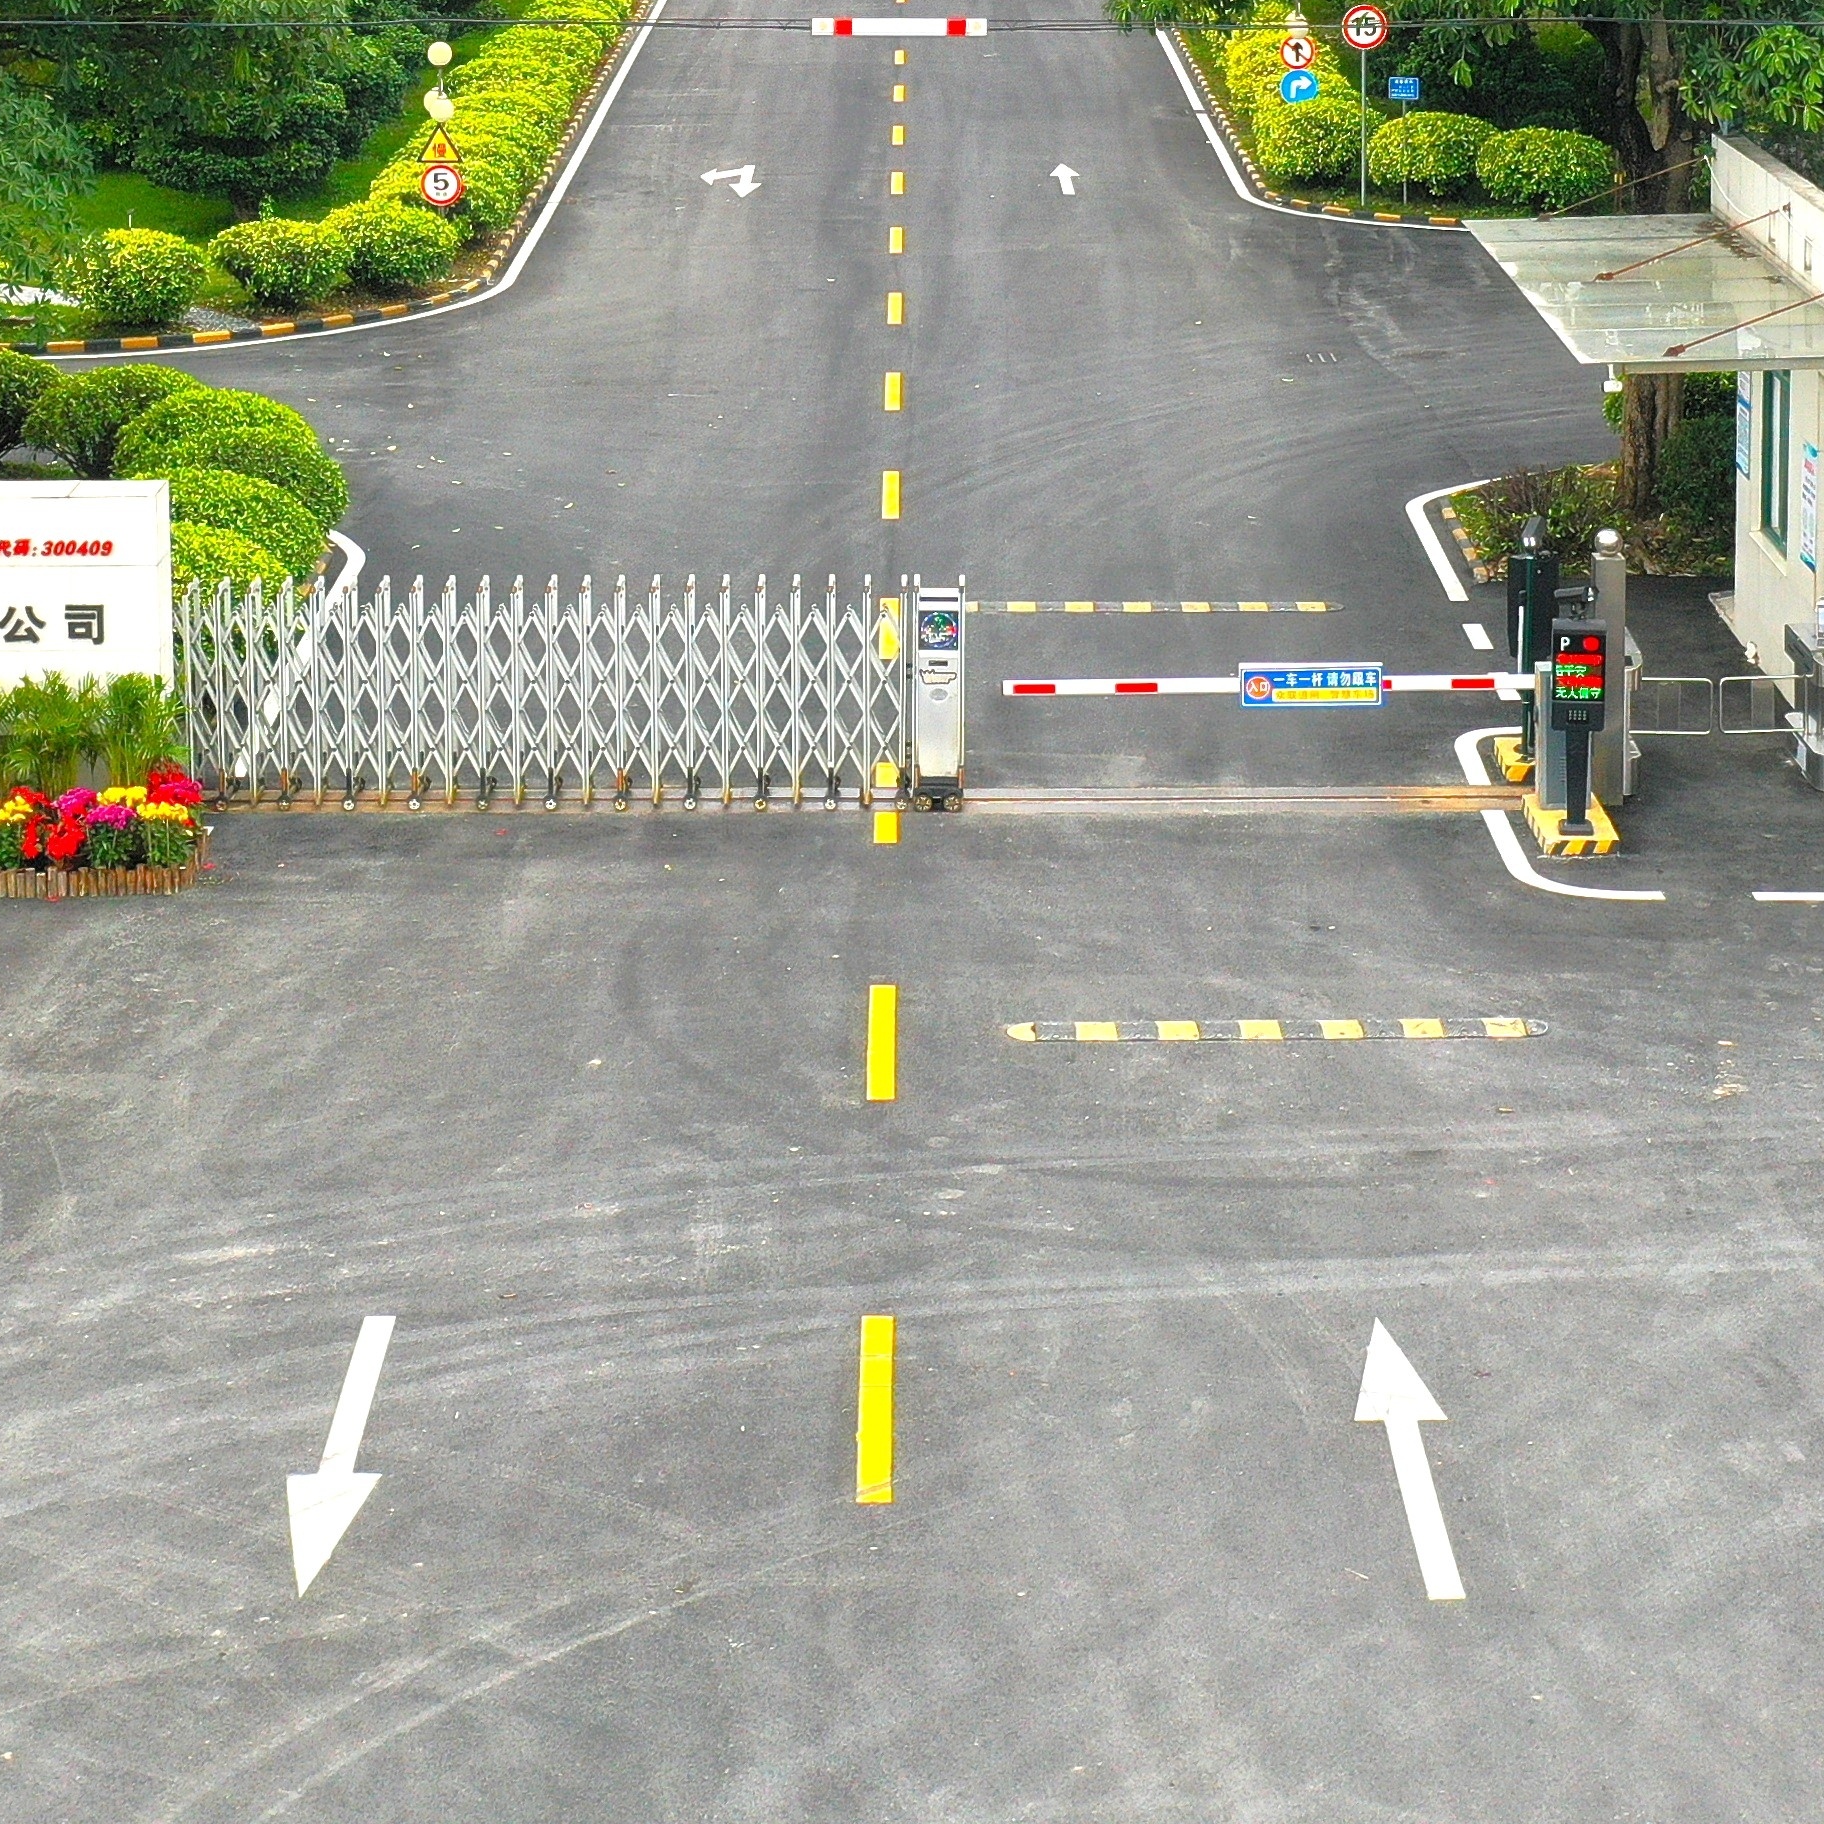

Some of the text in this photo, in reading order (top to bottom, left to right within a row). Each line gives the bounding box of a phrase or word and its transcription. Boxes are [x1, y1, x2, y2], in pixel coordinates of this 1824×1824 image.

[1351, 16, 1378, 39] 15
[432, 143, 447, 159] 慢
[433, 172, 450, 191] 5
[1248, 680, 1270, 694] 入口
[1273, 671, 1377, 687] 一车一杆 请勿跟车
[1555, 686, 1601, 700] 无人值守
